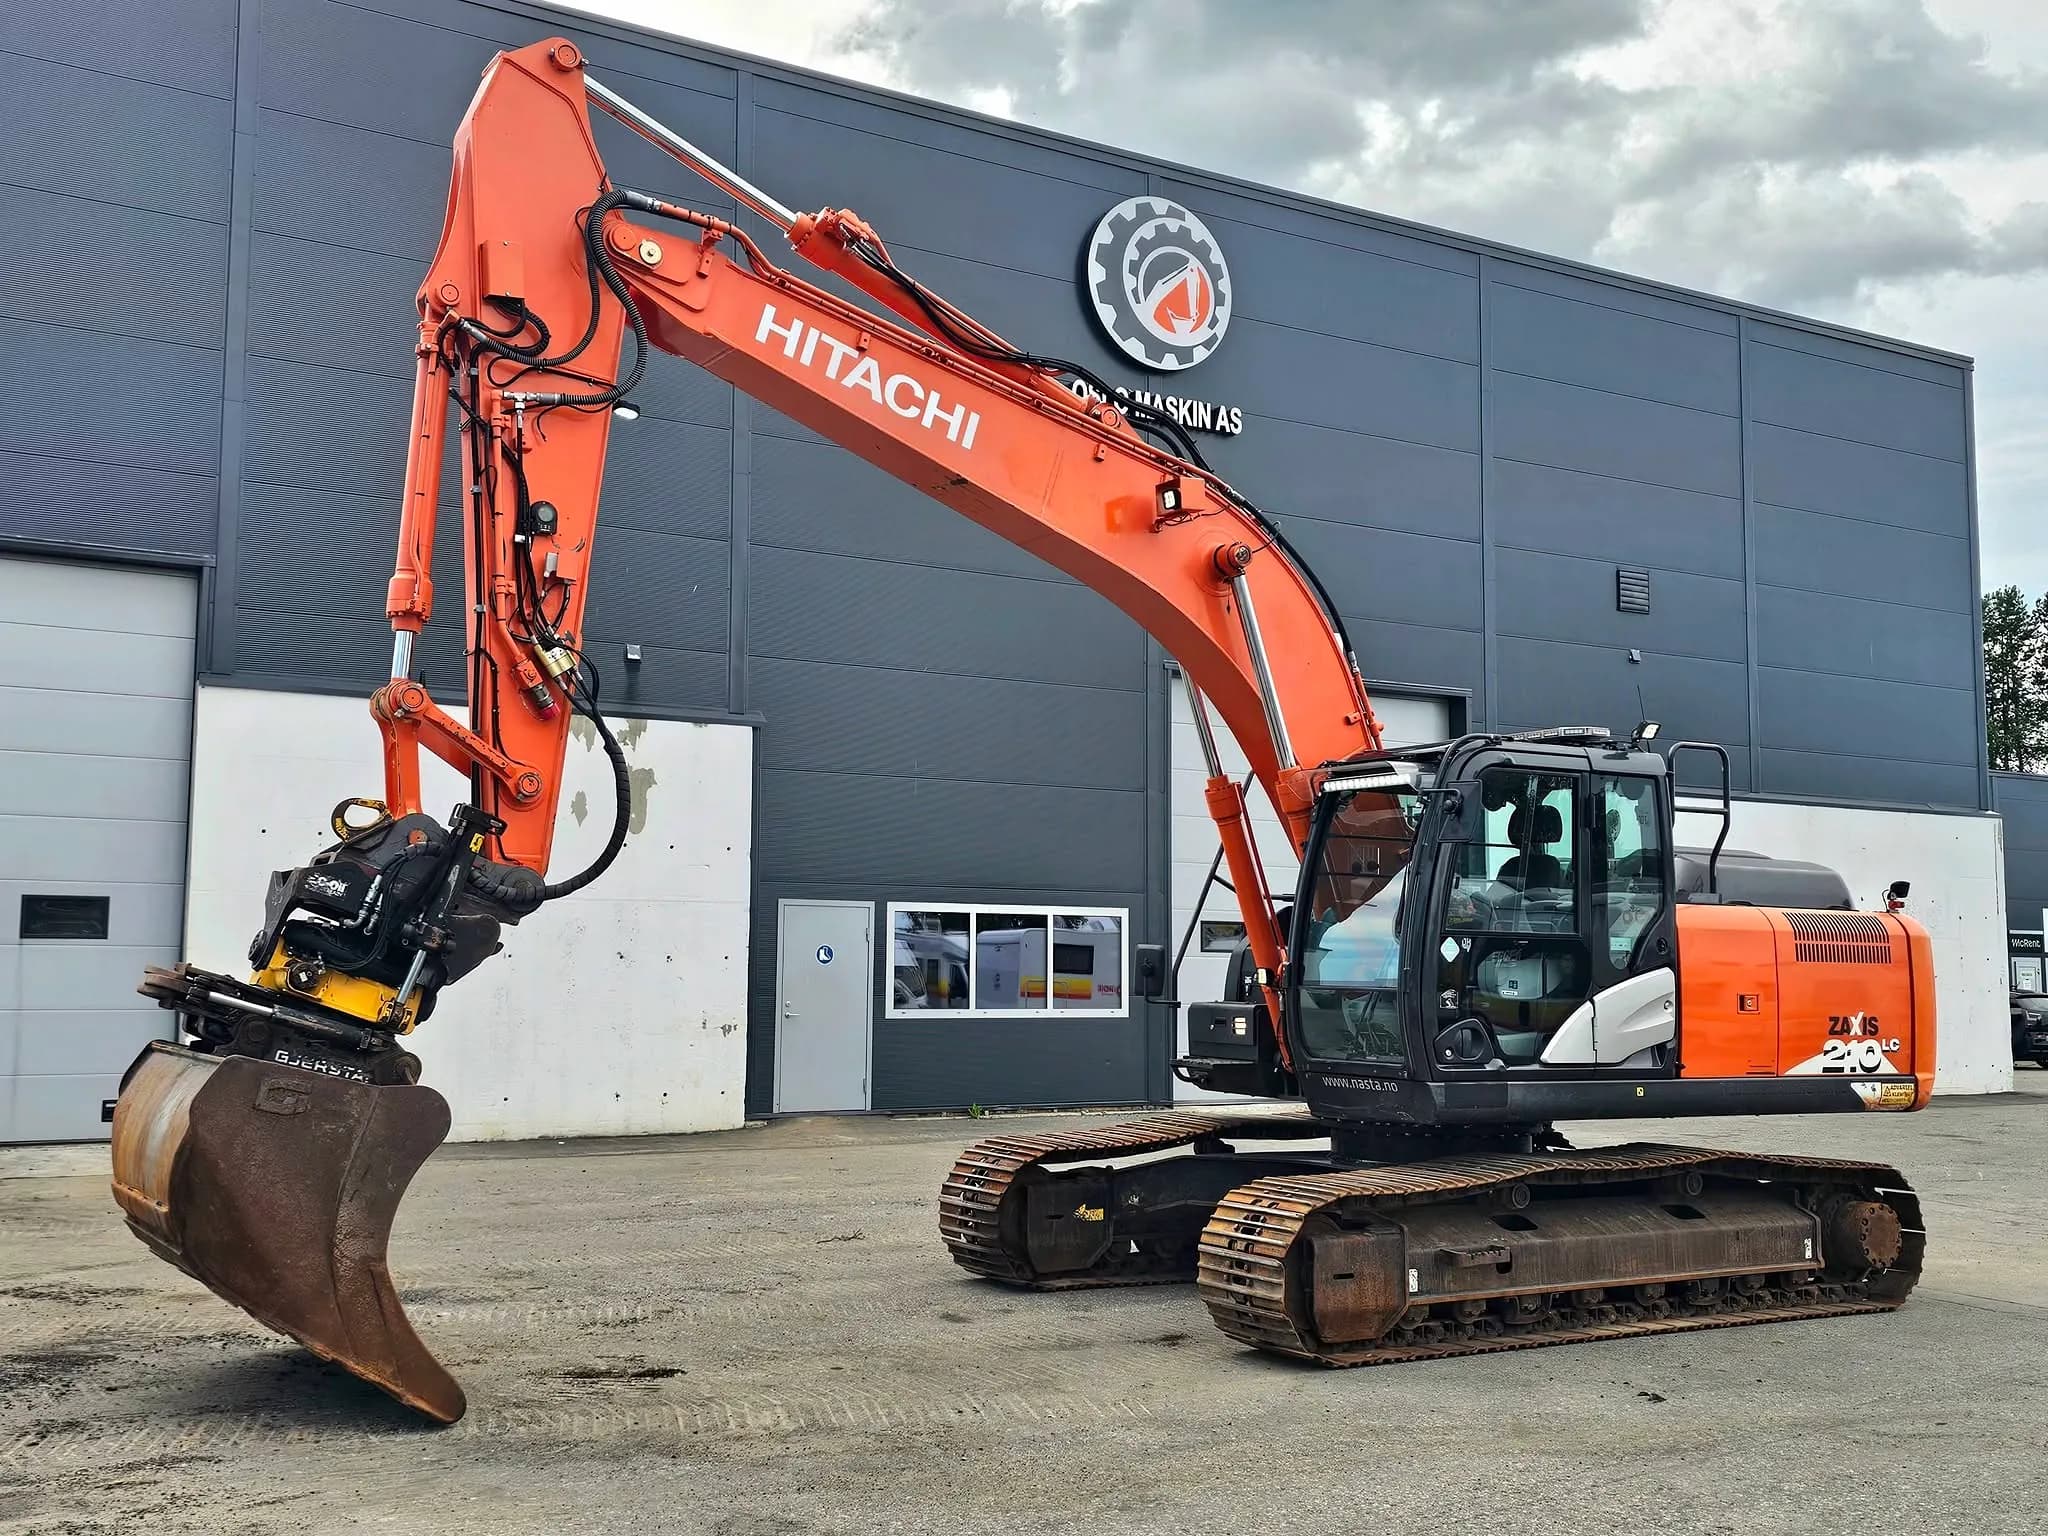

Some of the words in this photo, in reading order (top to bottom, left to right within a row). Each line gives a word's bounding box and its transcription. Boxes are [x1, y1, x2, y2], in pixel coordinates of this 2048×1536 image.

[755, 303, 980, 450] HITACHI
[1135, 390, 1211, 429] MASKIN
[1215, 405, 1242, 434] AS
[1828, 1011, 1879, 1036] ZAXIS
[274, 1049, 369, 1083] GJERSTA
[1822, 1039, 1881, 1074] 210
[1881, 1038, 1900, 1052] LC
[1322, 1076, 1398, 1092] www.nasta.no
